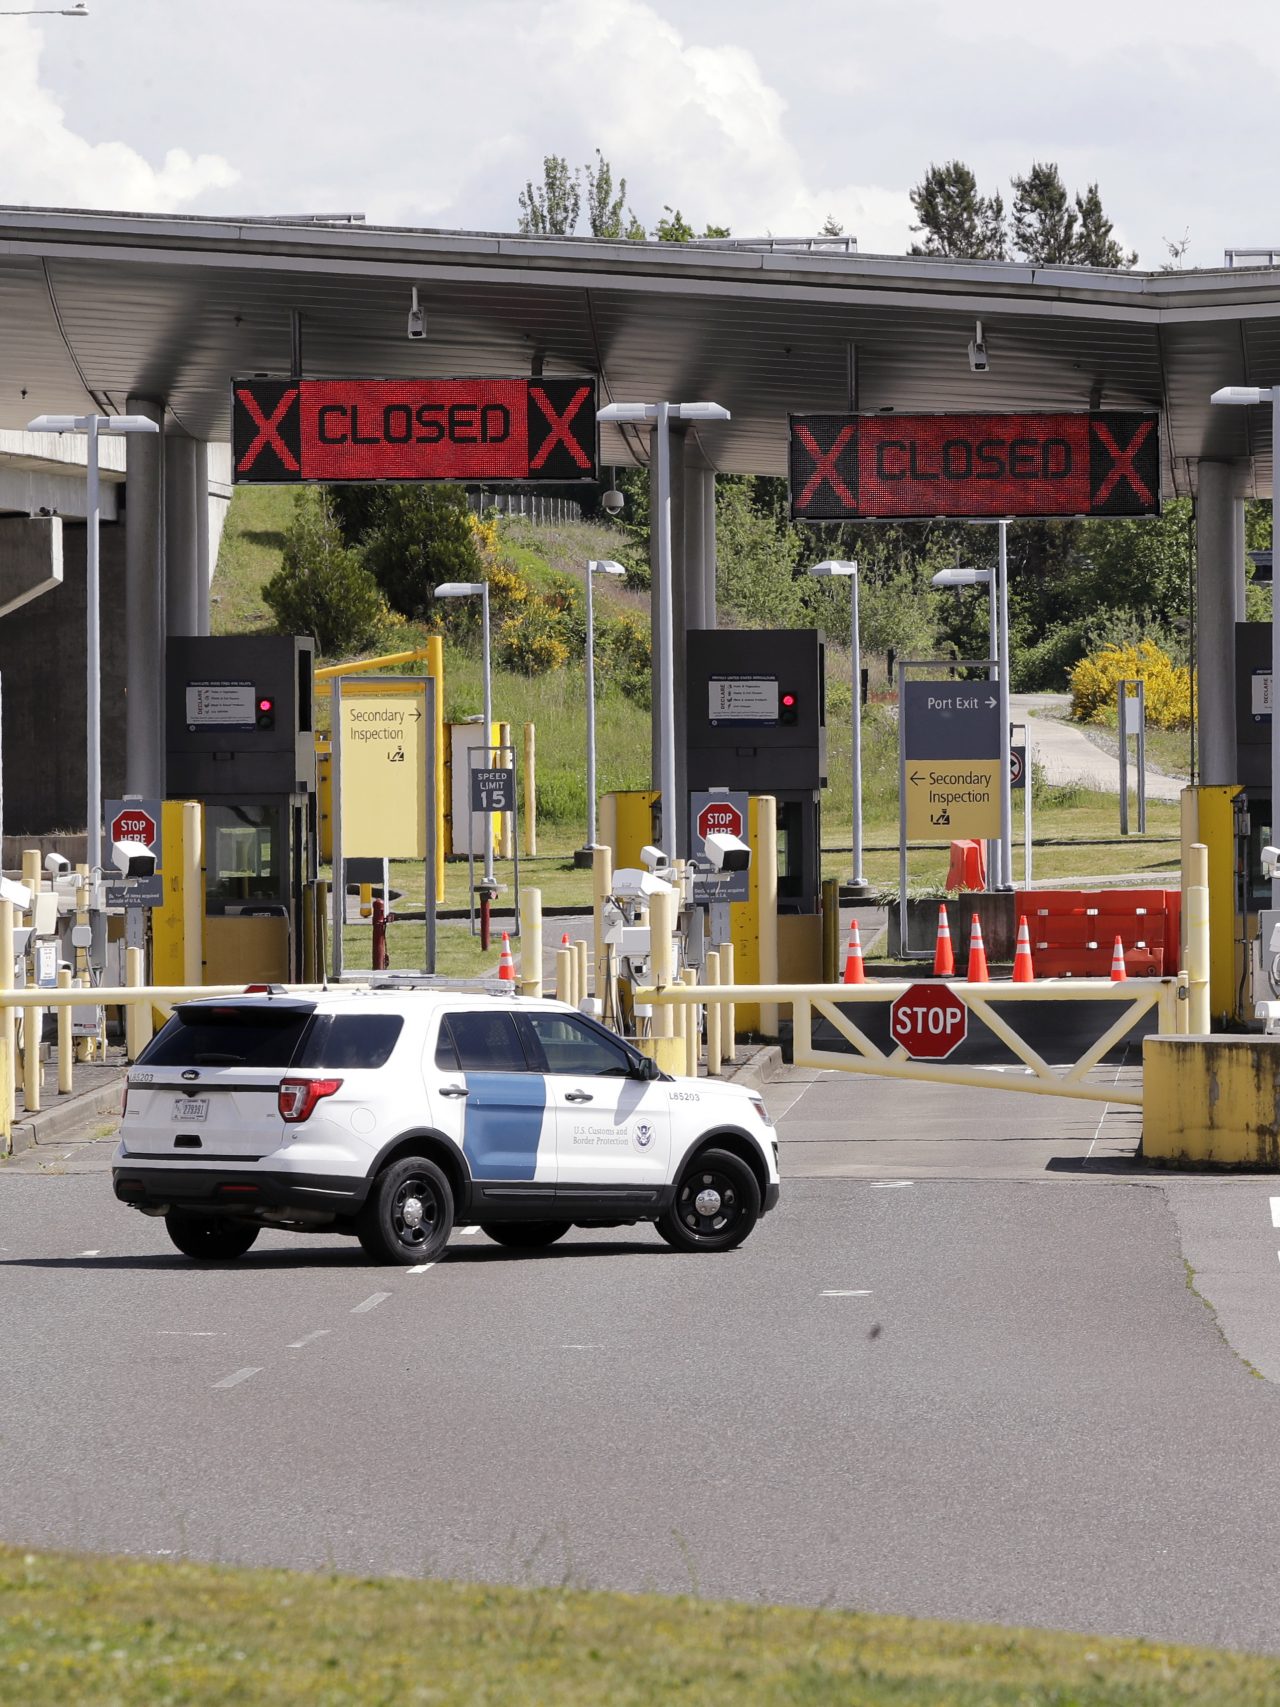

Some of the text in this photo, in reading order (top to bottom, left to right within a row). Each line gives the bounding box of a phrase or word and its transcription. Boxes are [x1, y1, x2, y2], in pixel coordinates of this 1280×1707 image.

[318, 404, 510, 444] CLOSED
[876, 438, 1073, 481] CLOSED
[928, 697, 978, 709] Port Exit
[350, 708, 405, 725] Secondary
[350, 727, 404, 743] Inspection
[480, 782, 504, 790] LIMIT
[929, 771, 992, 788] Secondary
[480, 790, 506, 808] 15
[929, 790, 990, 806] Inspection
[121, 820, 146, 831] STOP
[707, 813, 733, 824] STOP
[896, 1006, 962, 1034] STOP
[669, 1092, 700, 1101] L85203
[574, 1126, 628, 1136] U.S. Customs and
[573, 1137, 629, 1145] Border Protection
